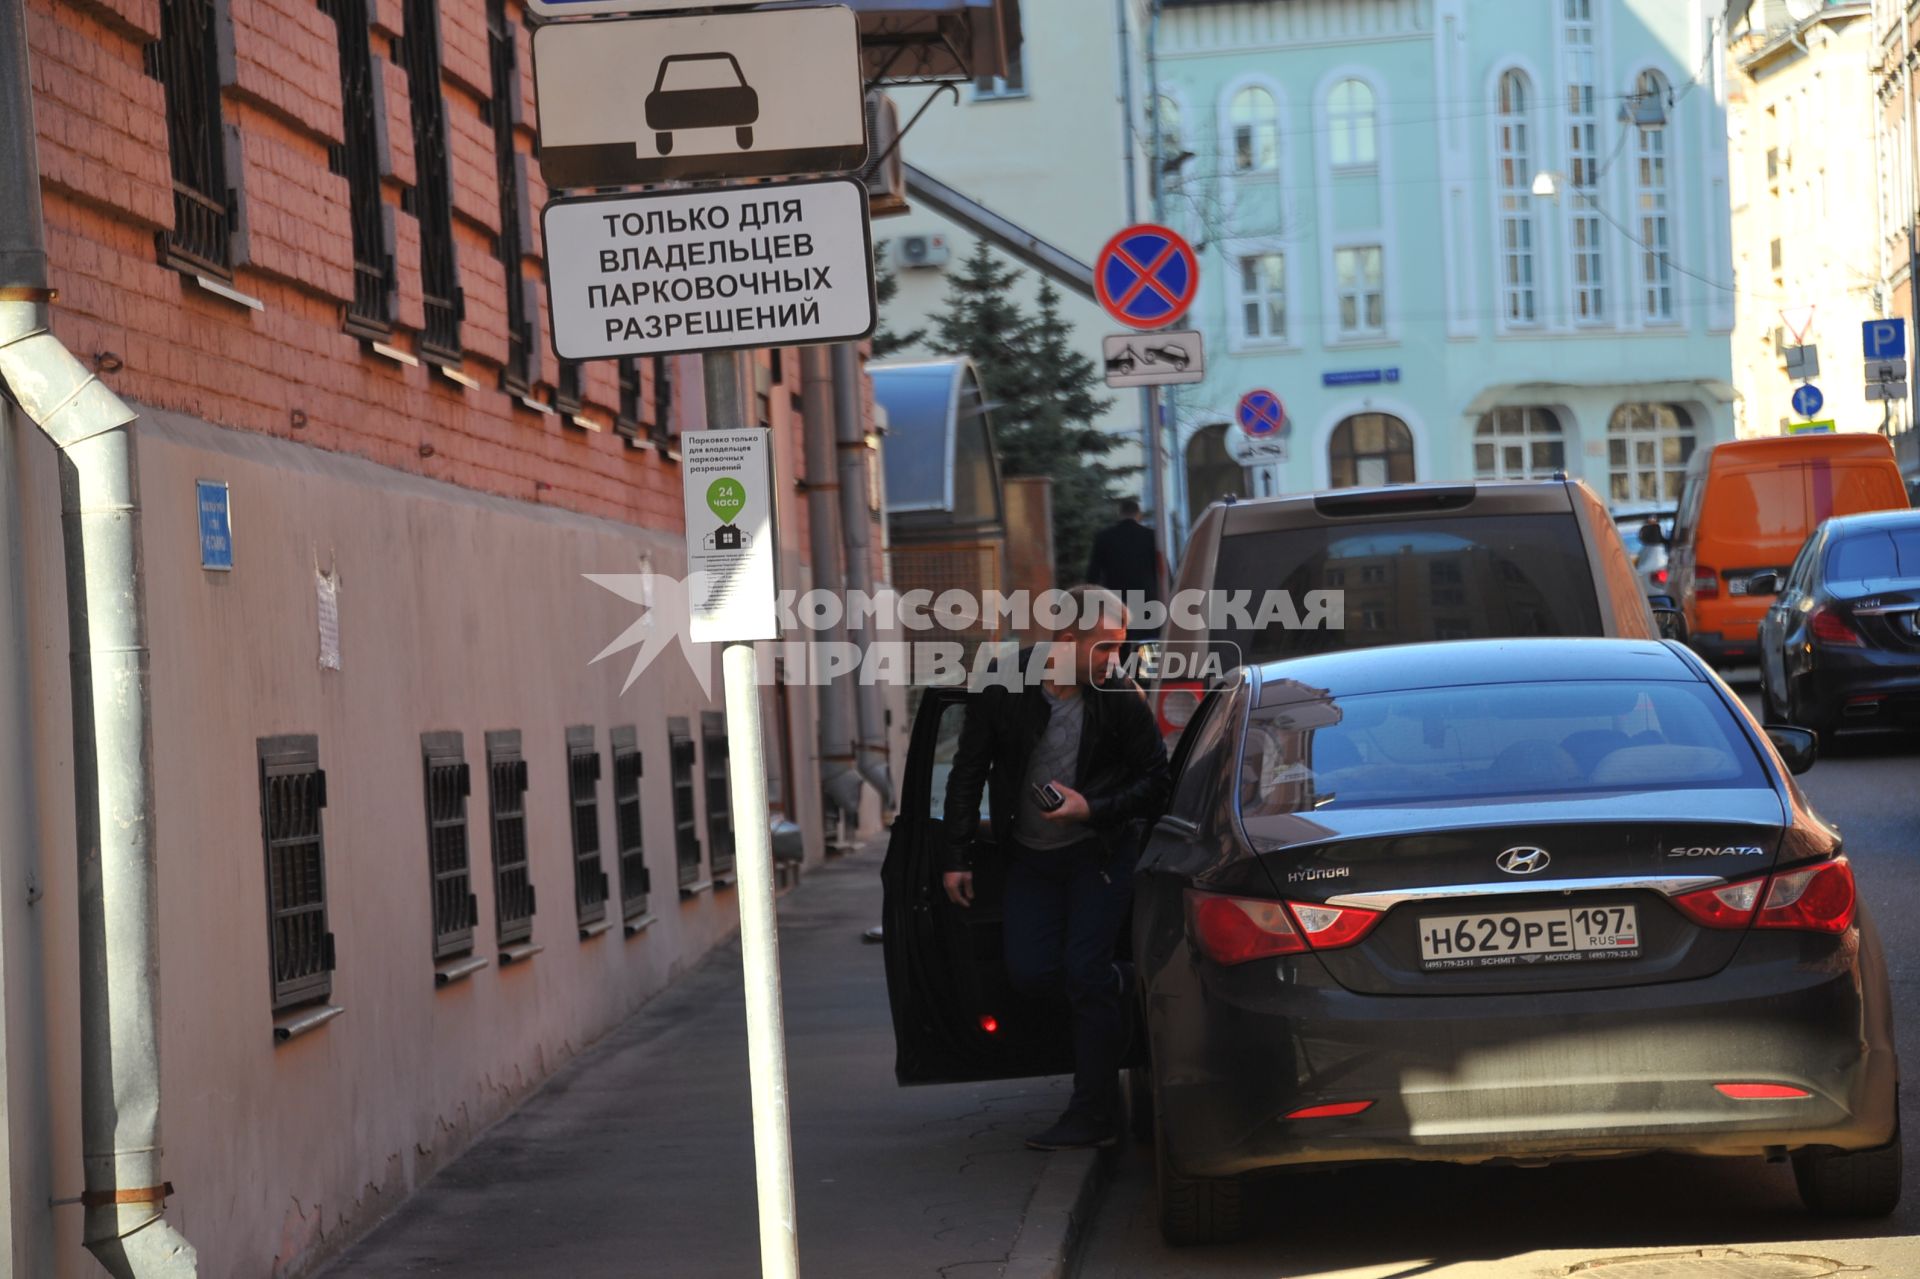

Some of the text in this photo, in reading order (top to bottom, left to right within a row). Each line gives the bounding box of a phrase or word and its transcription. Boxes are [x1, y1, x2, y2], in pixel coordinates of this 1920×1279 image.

[603, 199, 803, 238] ТОЛЬКО ДЛЯ
[599, 233, 814, 273] ВЛАДЕЛЬЦЕВ
[588, 266, 832, 309] ПАРКОВОЧНЫХ
[605, 298, 820, 342] РАЗРЕШЕНИЙ
[689, 437, 729, 445] Парковка
[689, 447, 703, 455] для
[690, 456, 744, 464] парковочных
[690, 464, 741, 474] разрешений
[718, 486, 733, 497] 24
[713, 498, 739, 507] часа
[1667, 846, 1764, 857] SONATA
[1288, 867, 1350, 882] HYUNDAI
[1431, 908, 1625, 954] Н629РЕ 197
[1589, 936, 1615, 946] RUS
[1481, 957, 1517, 966] SCHMIT
[1545, 952, 1582, 961] MOTORS
